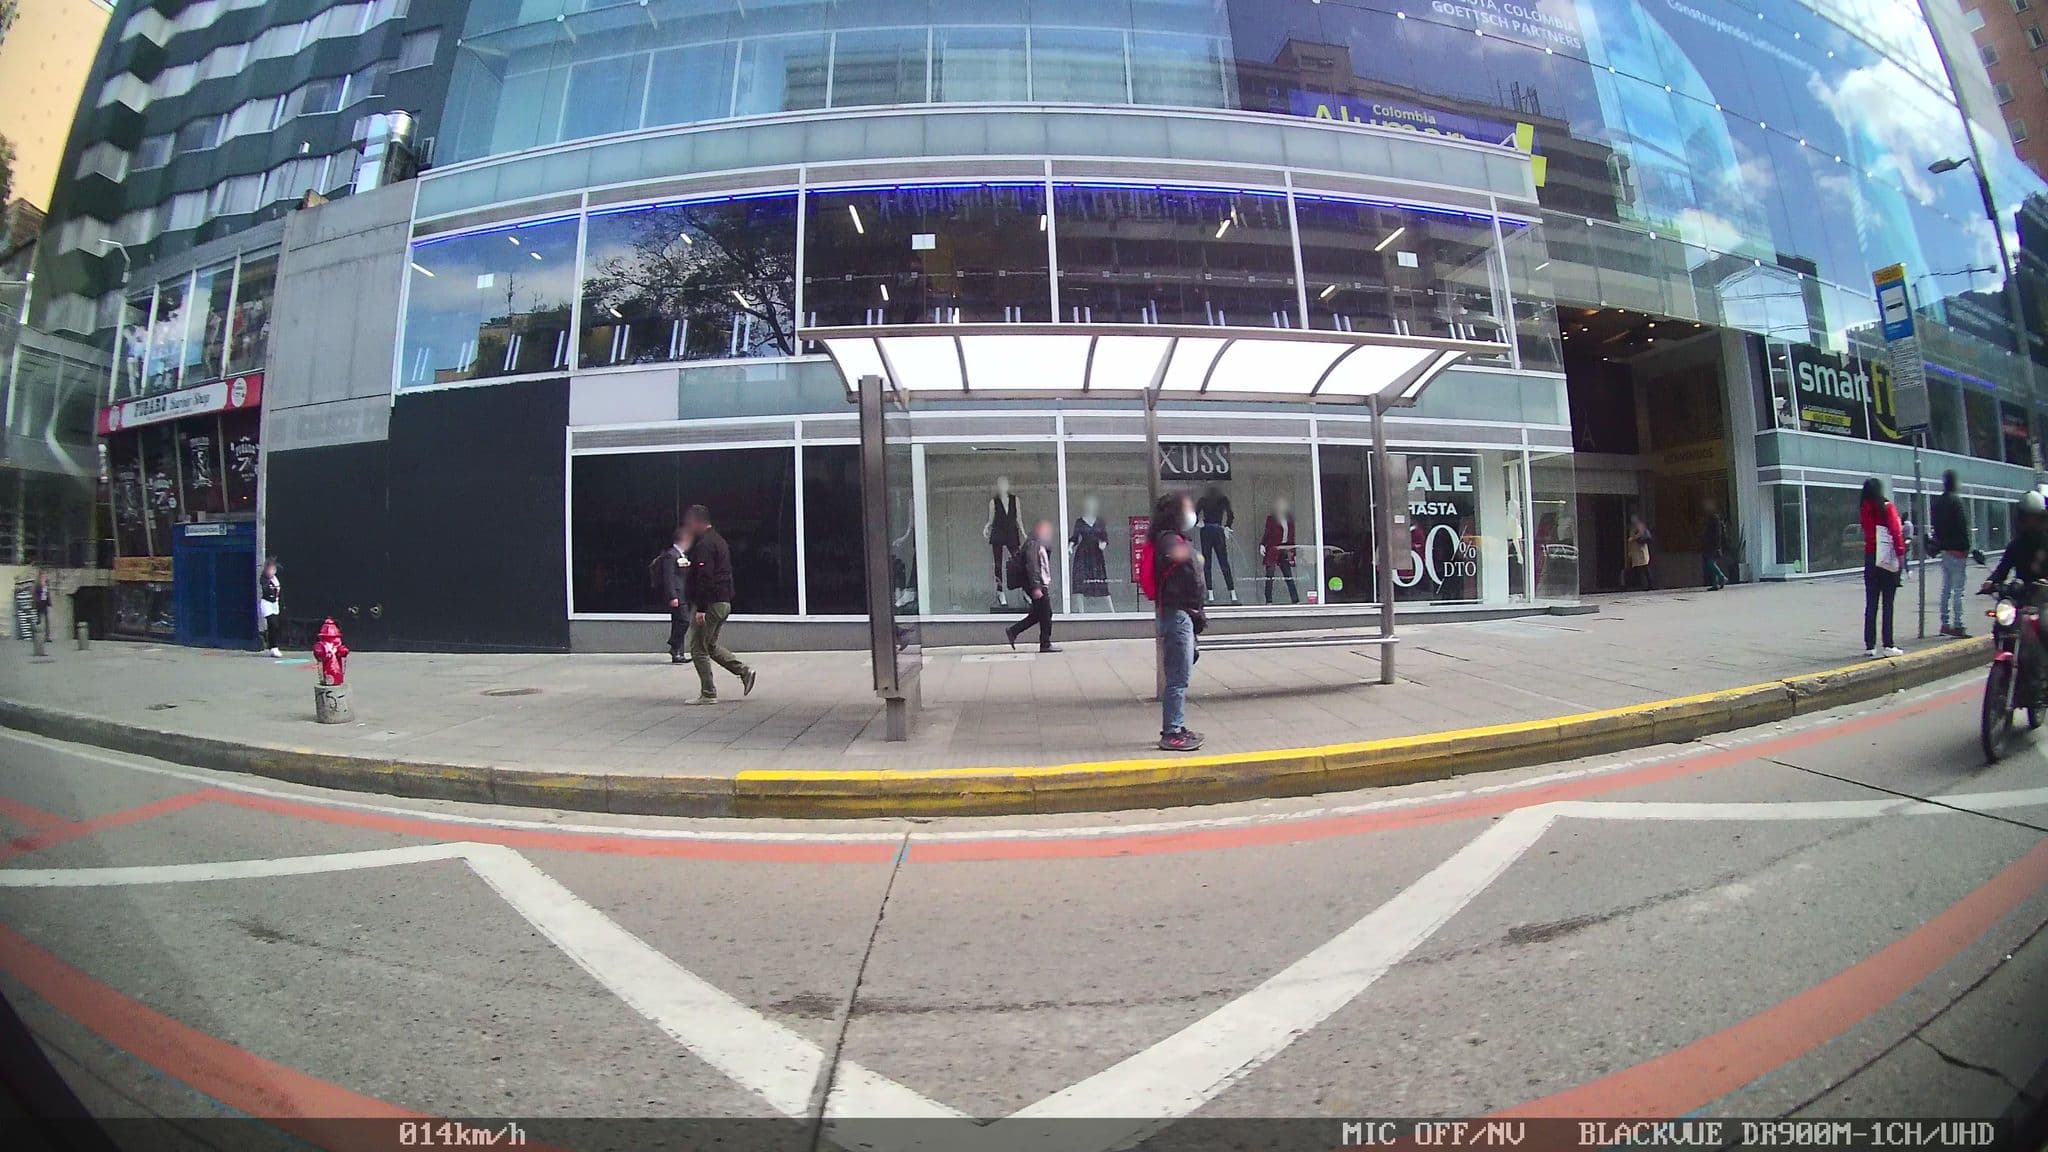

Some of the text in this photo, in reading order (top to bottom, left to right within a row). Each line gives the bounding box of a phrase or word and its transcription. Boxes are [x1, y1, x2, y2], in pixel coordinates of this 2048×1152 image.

[1432, 0, 1581, 49] GOETTSCH PARTNERS
[1504, 3, 1577, 33] COLOMBIA
[1373, 104, 1437, 125] Colombia
[1798, 361, 1873, 403] smart
[1407, 465, 1474, 492] ALE
[1443, 561, 1477, 577] DTO
